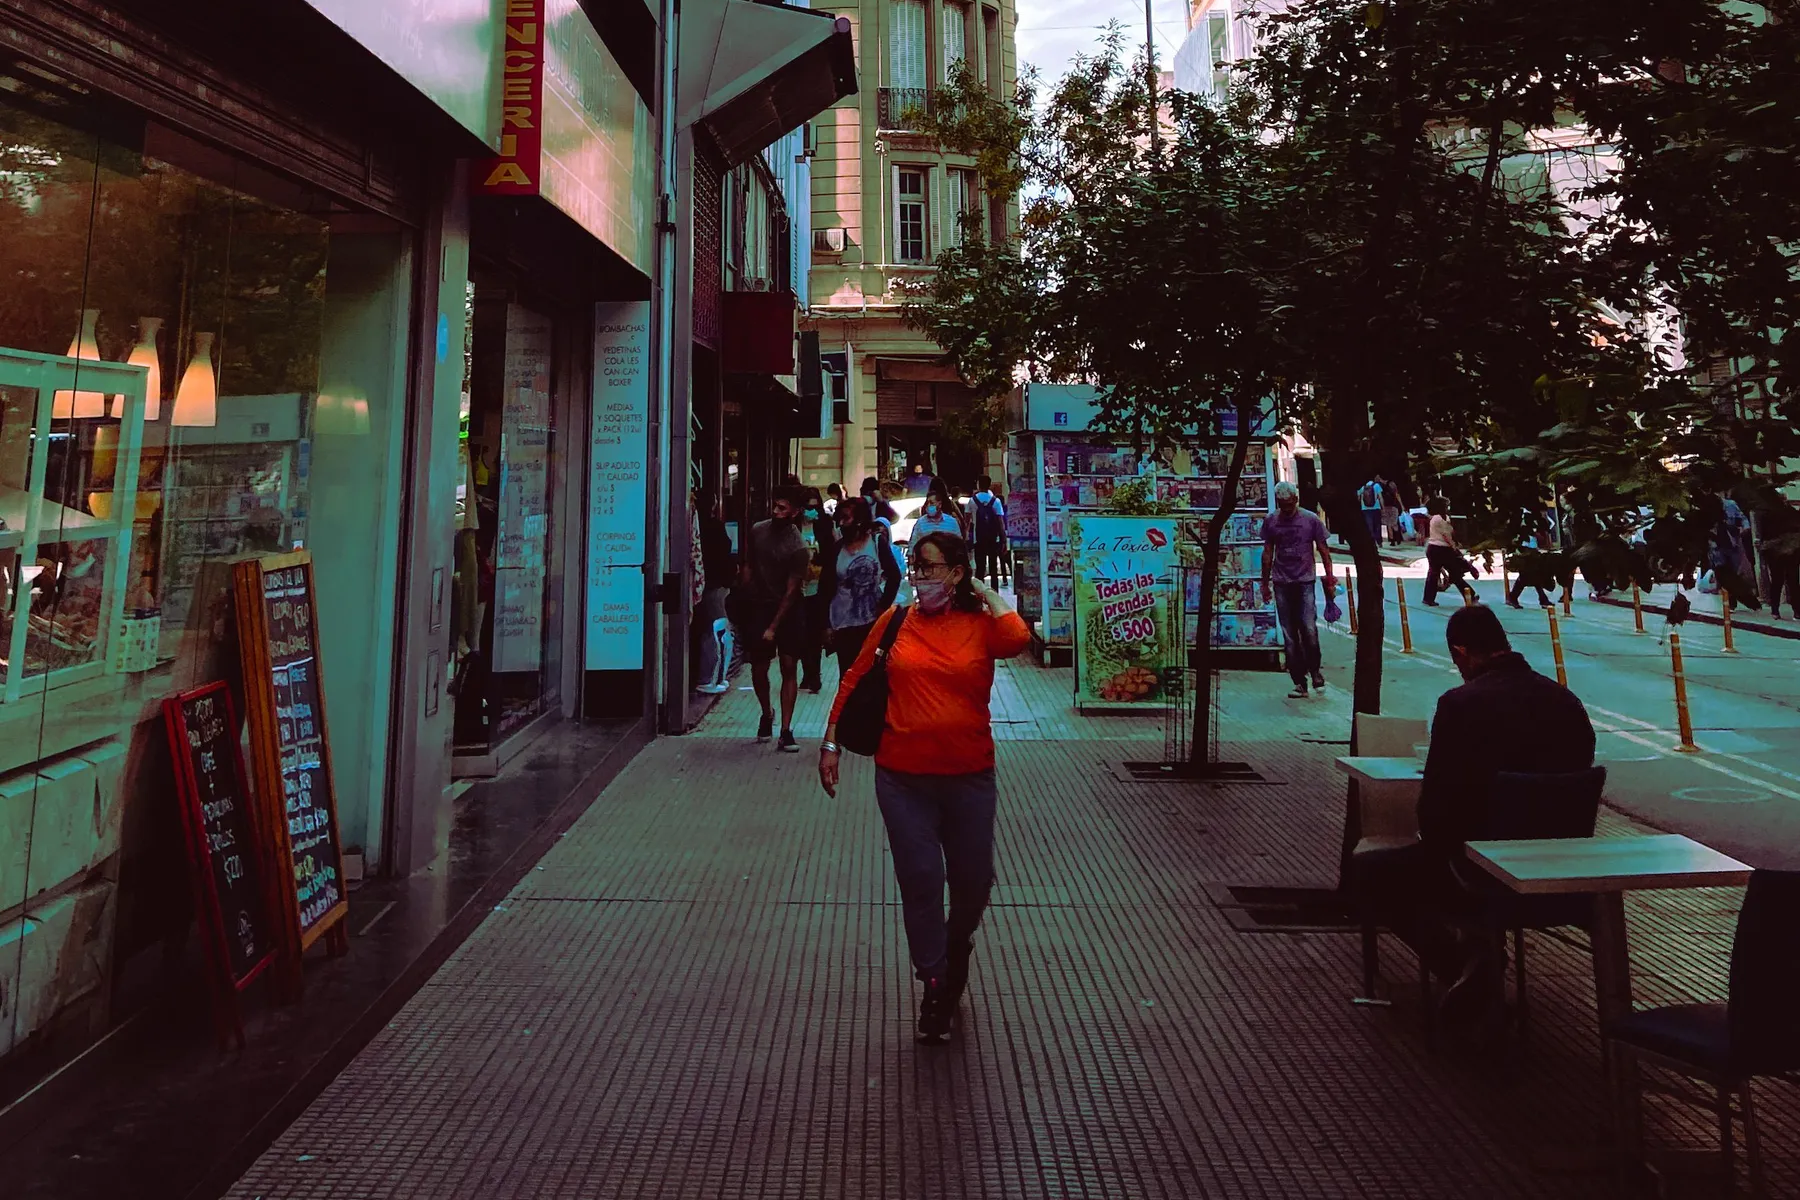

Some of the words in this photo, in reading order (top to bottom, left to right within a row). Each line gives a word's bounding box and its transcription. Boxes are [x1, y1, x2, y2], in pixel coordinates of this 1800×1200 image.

[605, 357, 625, 366] COLA
[608, 378, 633, 387] BOXER
[607, 403, 635, 412] MEDIAS
[1086, 536, 1106, 551] La
[1095, 578, 1135, 600] Todas
[1134, 572, 1155, 589] las
[1103, 592, 1155, 622] prendas
